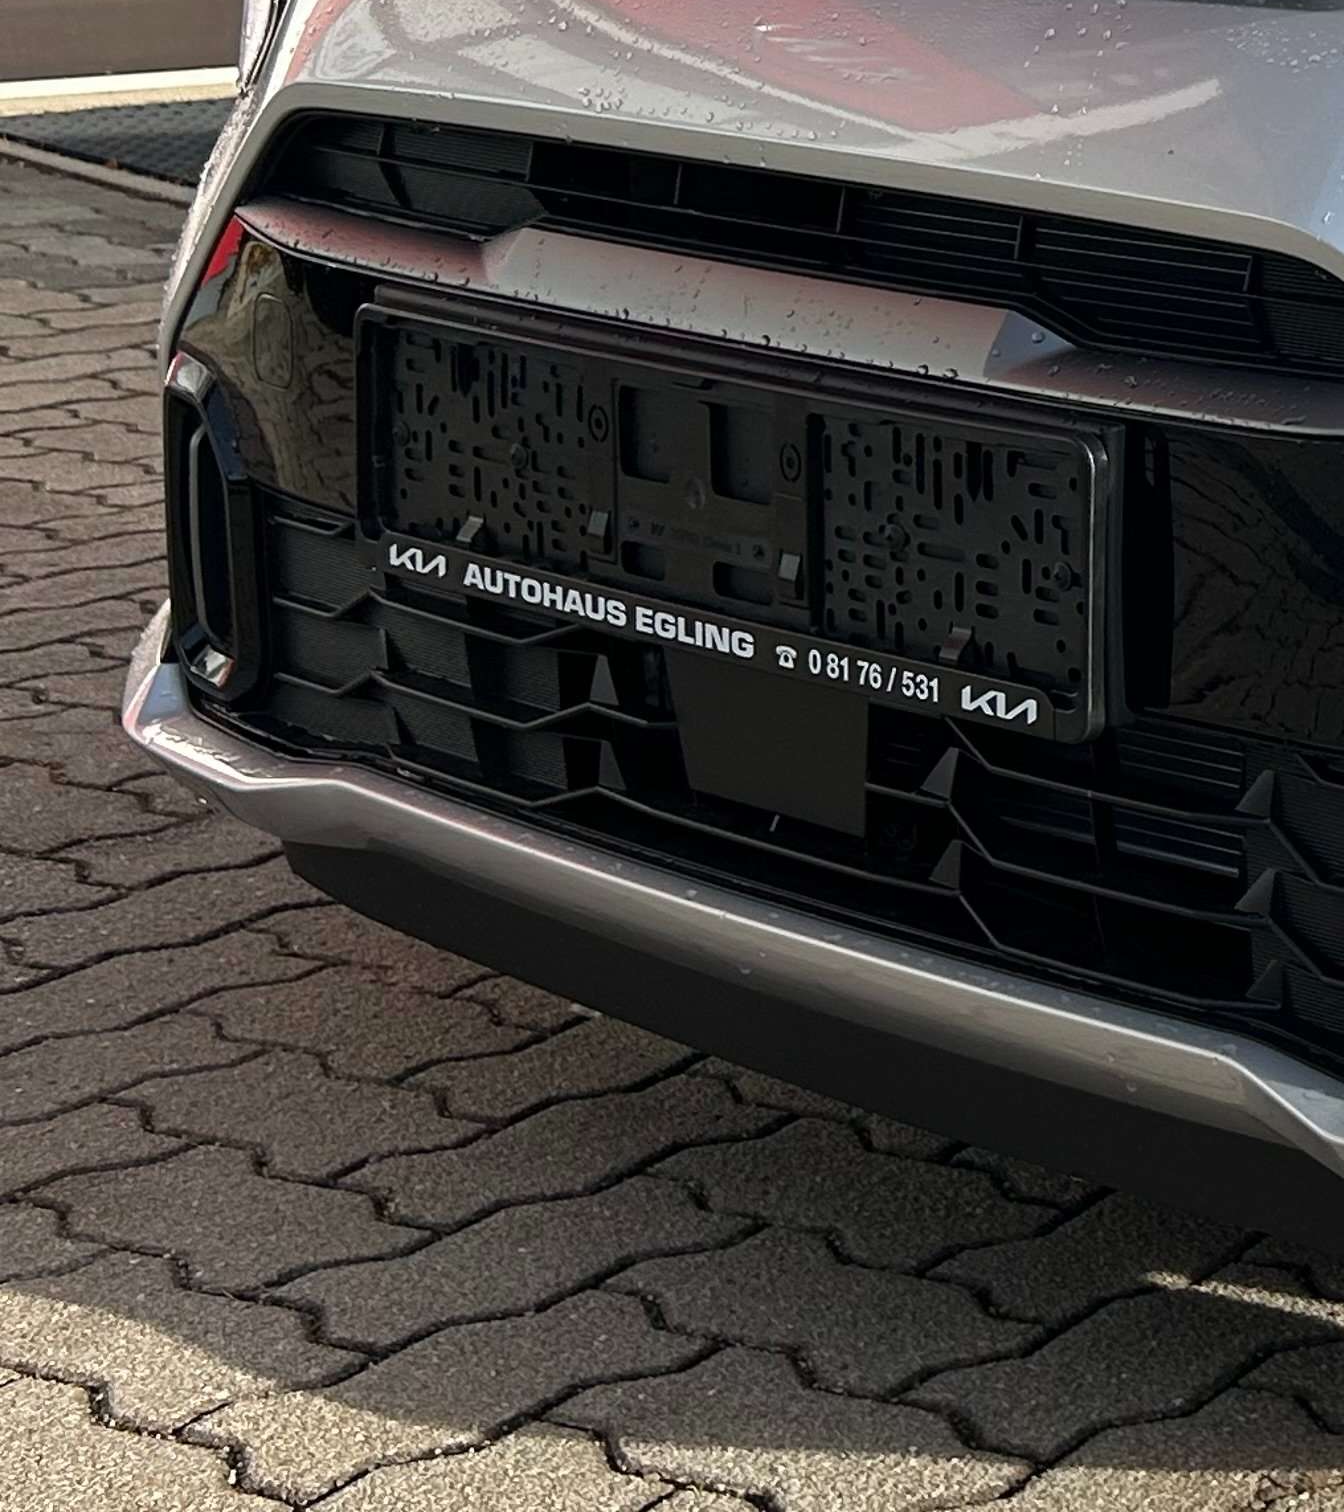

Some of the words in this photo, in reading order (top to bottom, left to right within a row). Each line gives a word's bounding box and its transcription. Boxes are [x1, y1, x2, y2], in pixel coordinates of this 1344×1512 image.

[462, 562, 628, 628] AUTOHAUS
[635, 605, 755, 659] EGLING
[826, 652, 850, 682] 81
[856, 660, 883, 689] 76
[901, 671, 940, 703] 531
